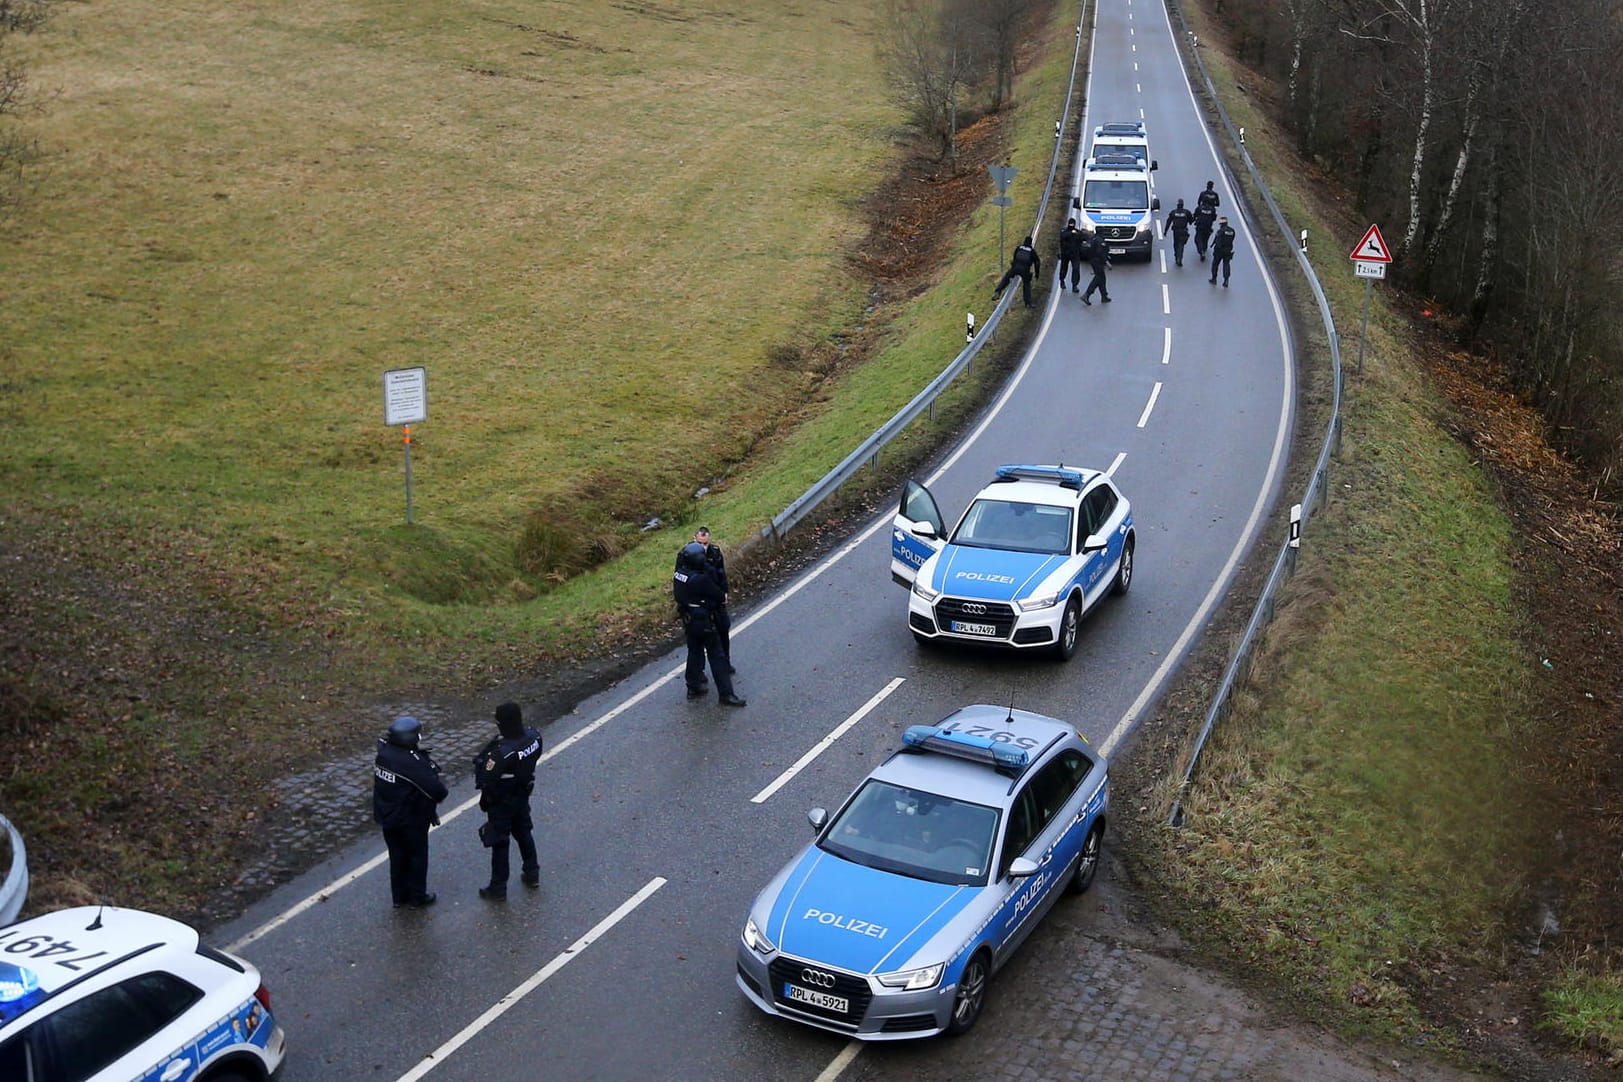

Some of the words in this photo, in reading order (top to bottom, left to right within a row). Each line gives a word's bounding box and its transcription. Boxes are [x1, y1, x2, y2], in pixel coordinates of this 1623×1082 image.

[901, 545, 926, 566] POLIZE
[955, 571, 1015, 585] POLIZEI
[978, 625, 994, 635] 7492
[374, 767, 396, 783] OLIZEI
[1014, 872, 1044, 917] POLIZEI
[803, 908, 888, 939] POLIZEI
[790, 987, 808, 1001] RPL
[810, 993, 816, 1003] 4
[822, 995, 846, 1011] 5921
